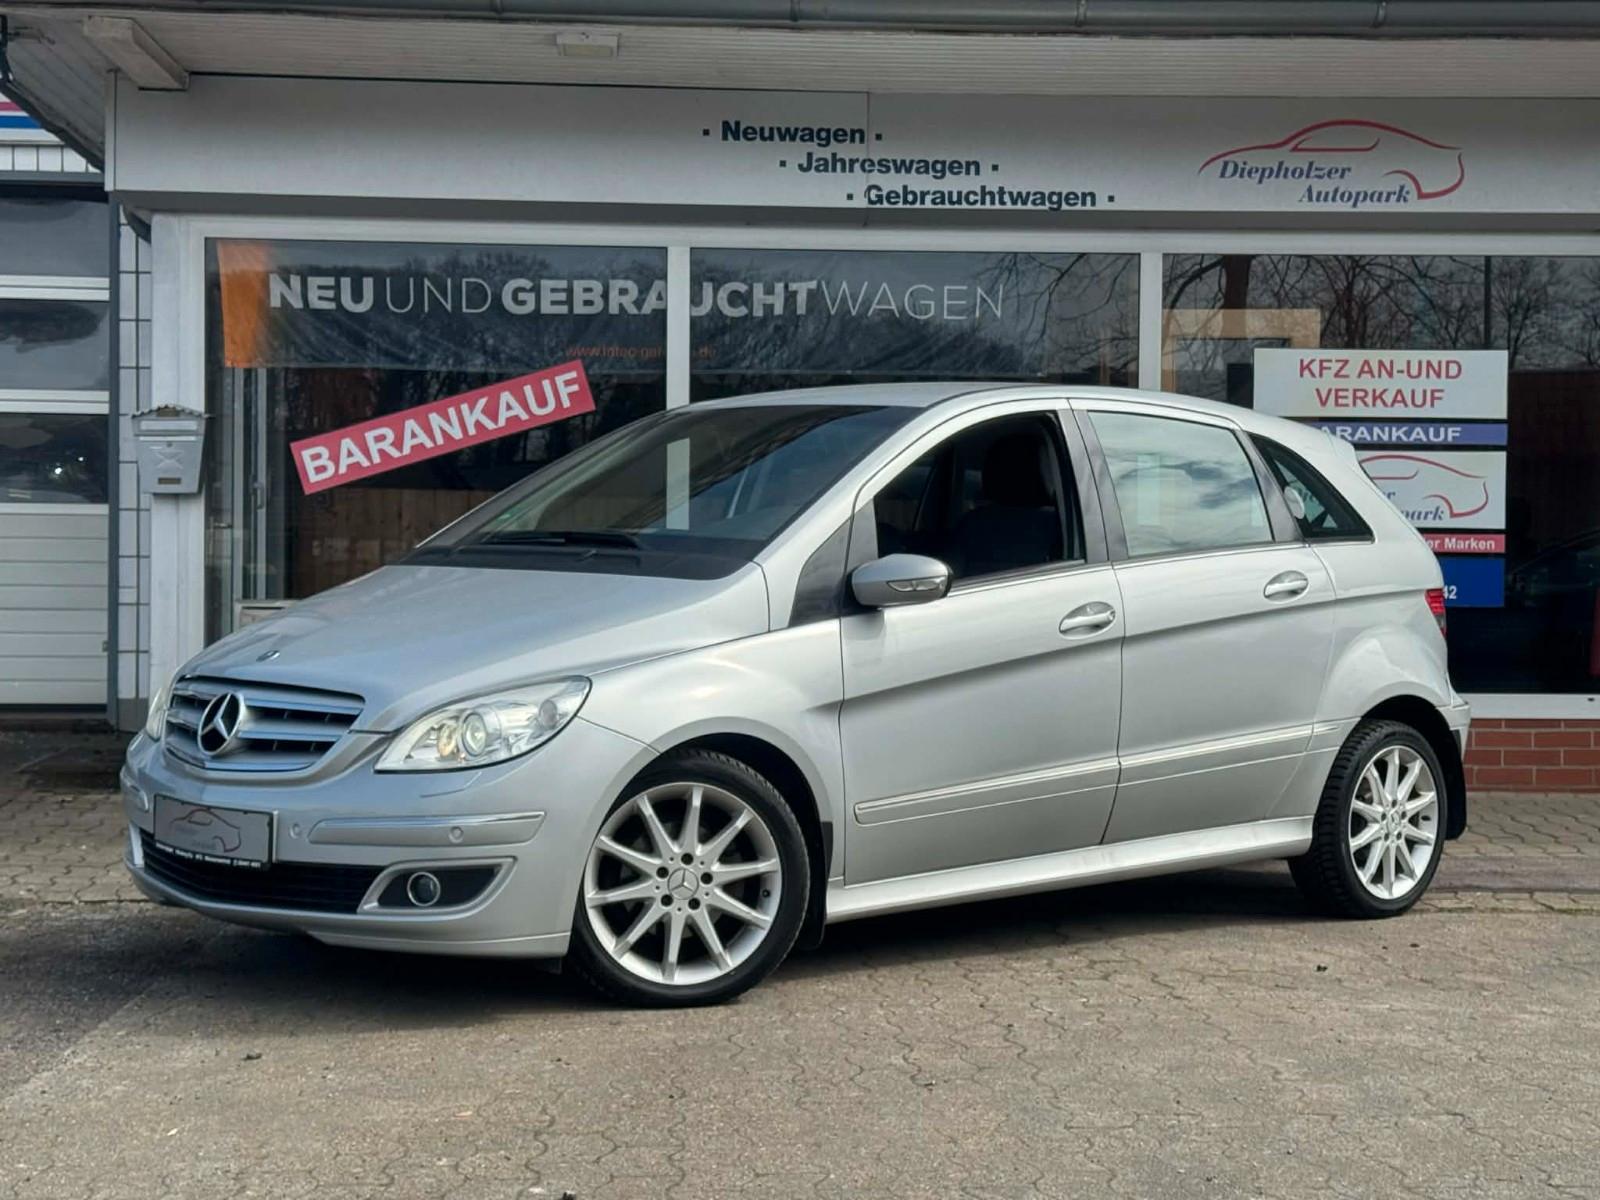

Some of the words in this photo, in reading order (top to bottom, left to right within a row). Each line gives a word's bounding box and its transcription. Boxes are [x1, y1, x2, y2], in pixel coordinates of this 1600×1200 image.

[721, 120, 866, 147] Neuwagen
[797, 152, 980, 179] Jahreswagen
[1218, 160, 1352, 184] Diepholzer
[865, 184, 1097, 211] Gebrauchtwagen
[1299, 184, 1410, 208] Autopark
[269, 273, 373, 313] NEU
[386, 277, 492, 314] UND
[1299, 358, 1350, 380] KFZ
[1357, 359, 1462, 380] AN-UND
[1315, 388, 1445, 409] VERKAUF
[301, 370, 582, 484] BARANKAUF
[1444, 537, 1496, 550] Marken
